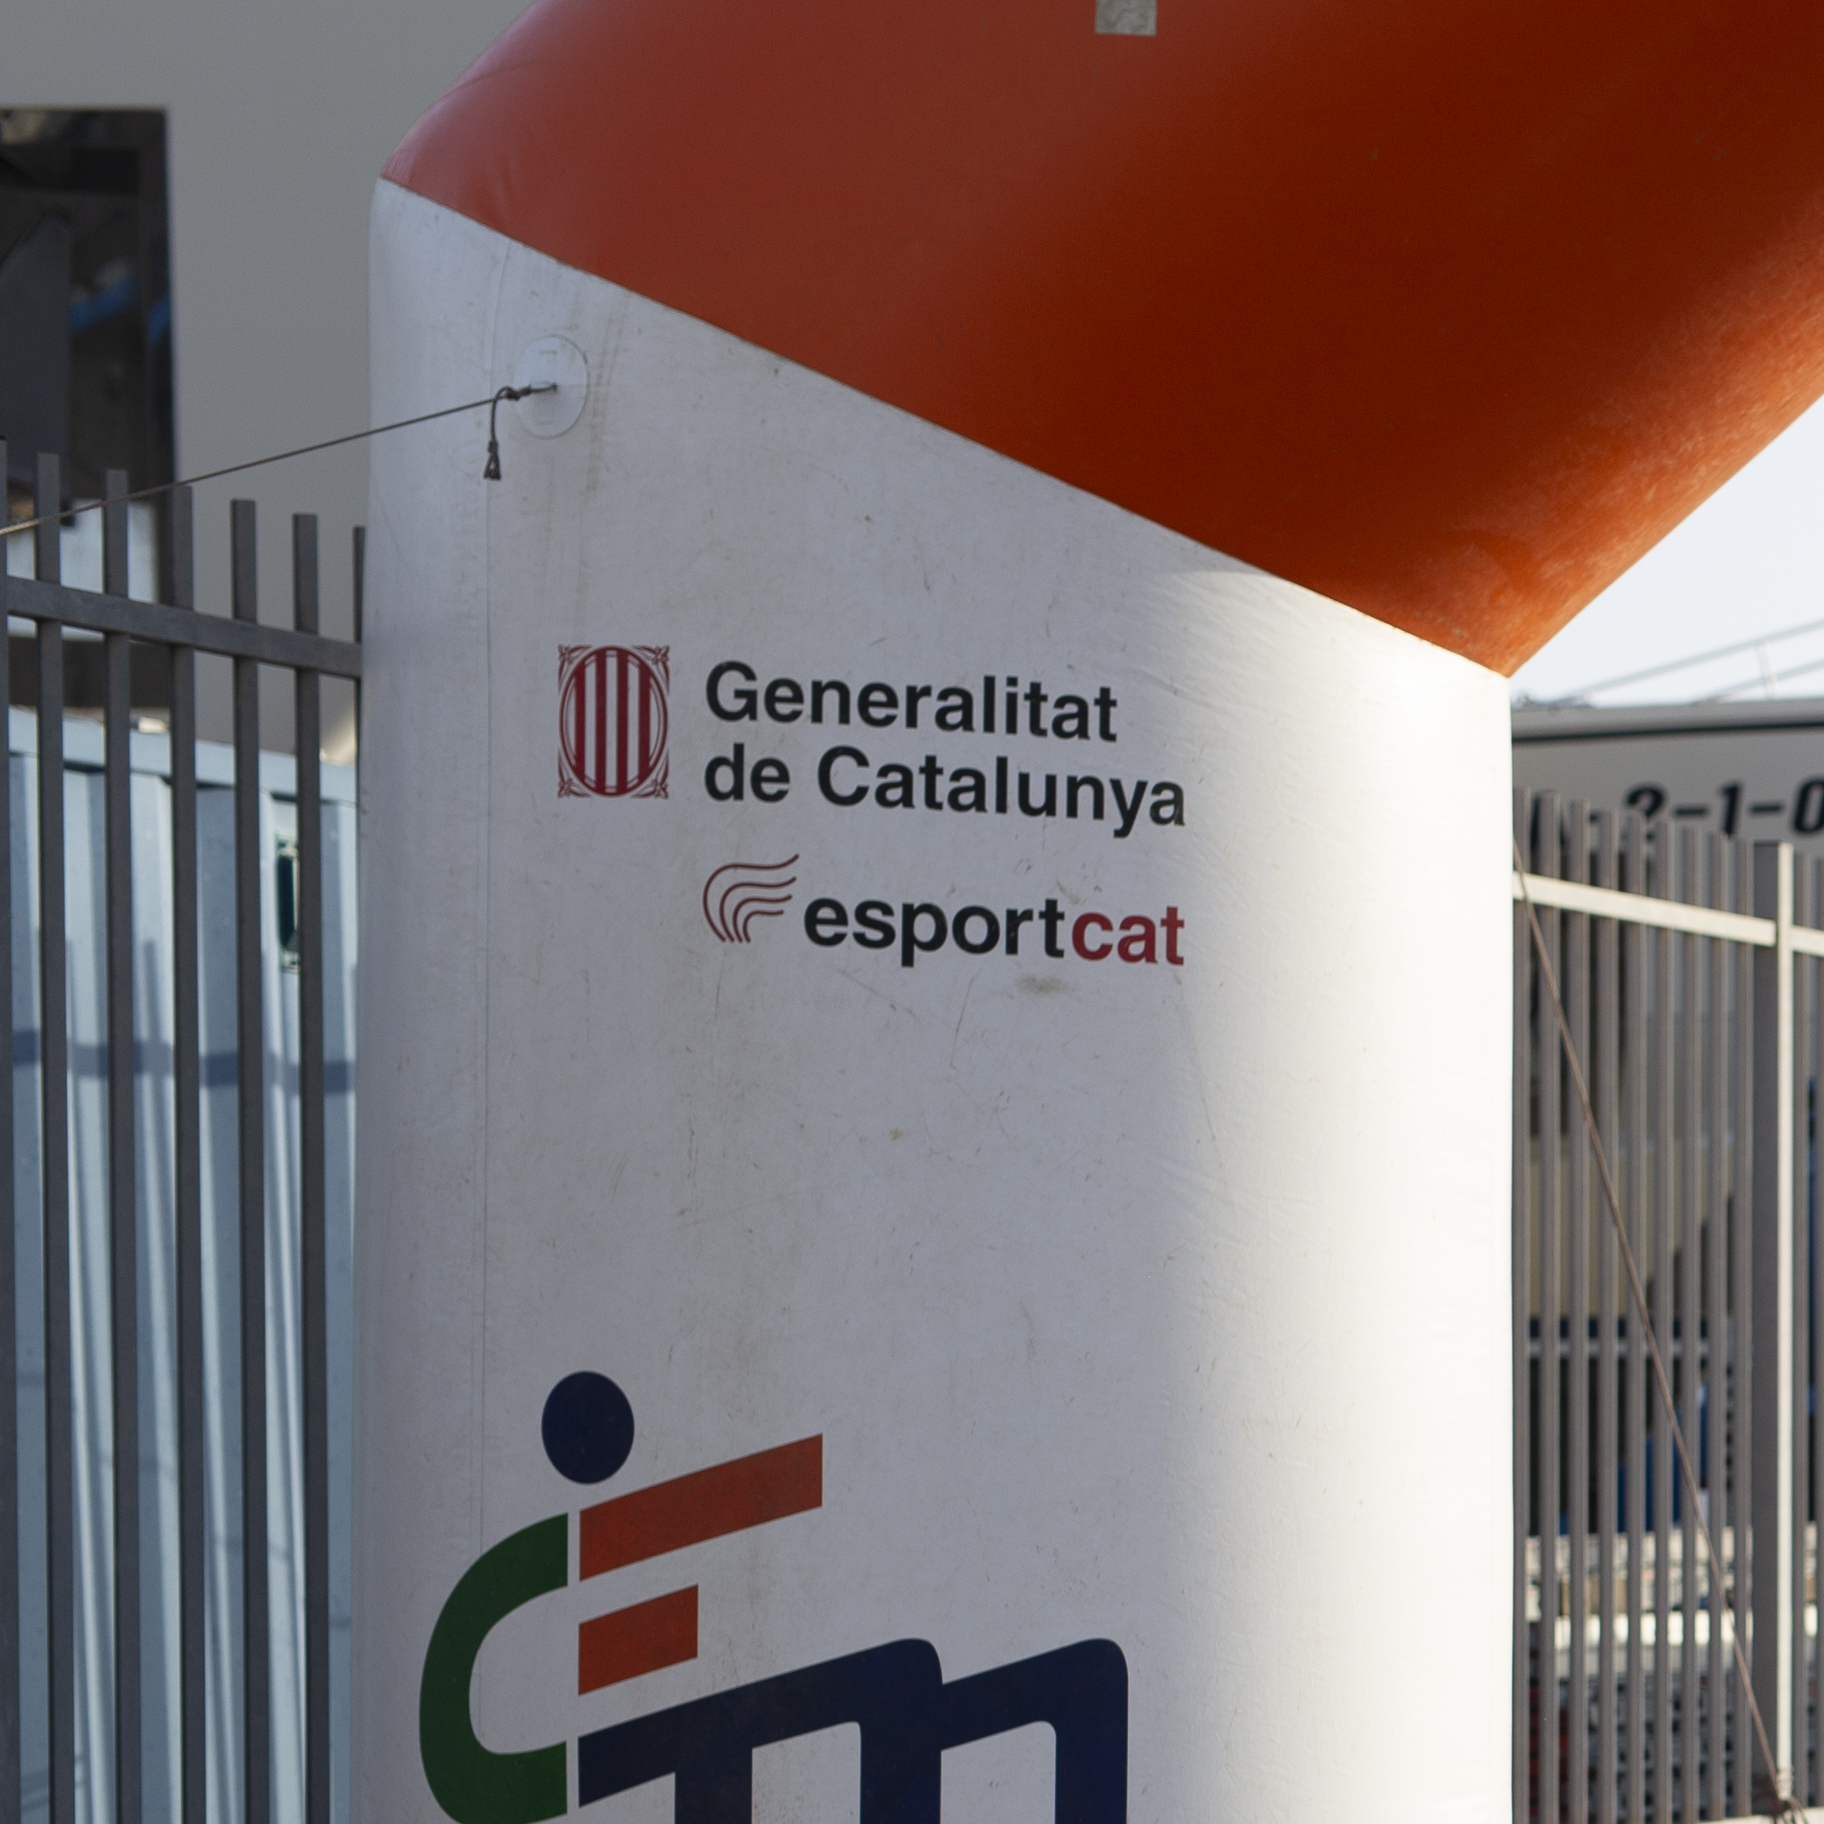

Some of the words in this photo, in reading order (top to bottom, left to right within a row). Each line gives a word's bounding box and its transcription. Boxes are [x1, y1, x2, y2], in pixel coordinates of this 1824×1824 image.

[704, 660, 1118, 742] Generalitat
[703, 743, 792, 803] de
[817, 745, 1185, 840] Catalunya
[804, 897, 1185, 968] esportcat
